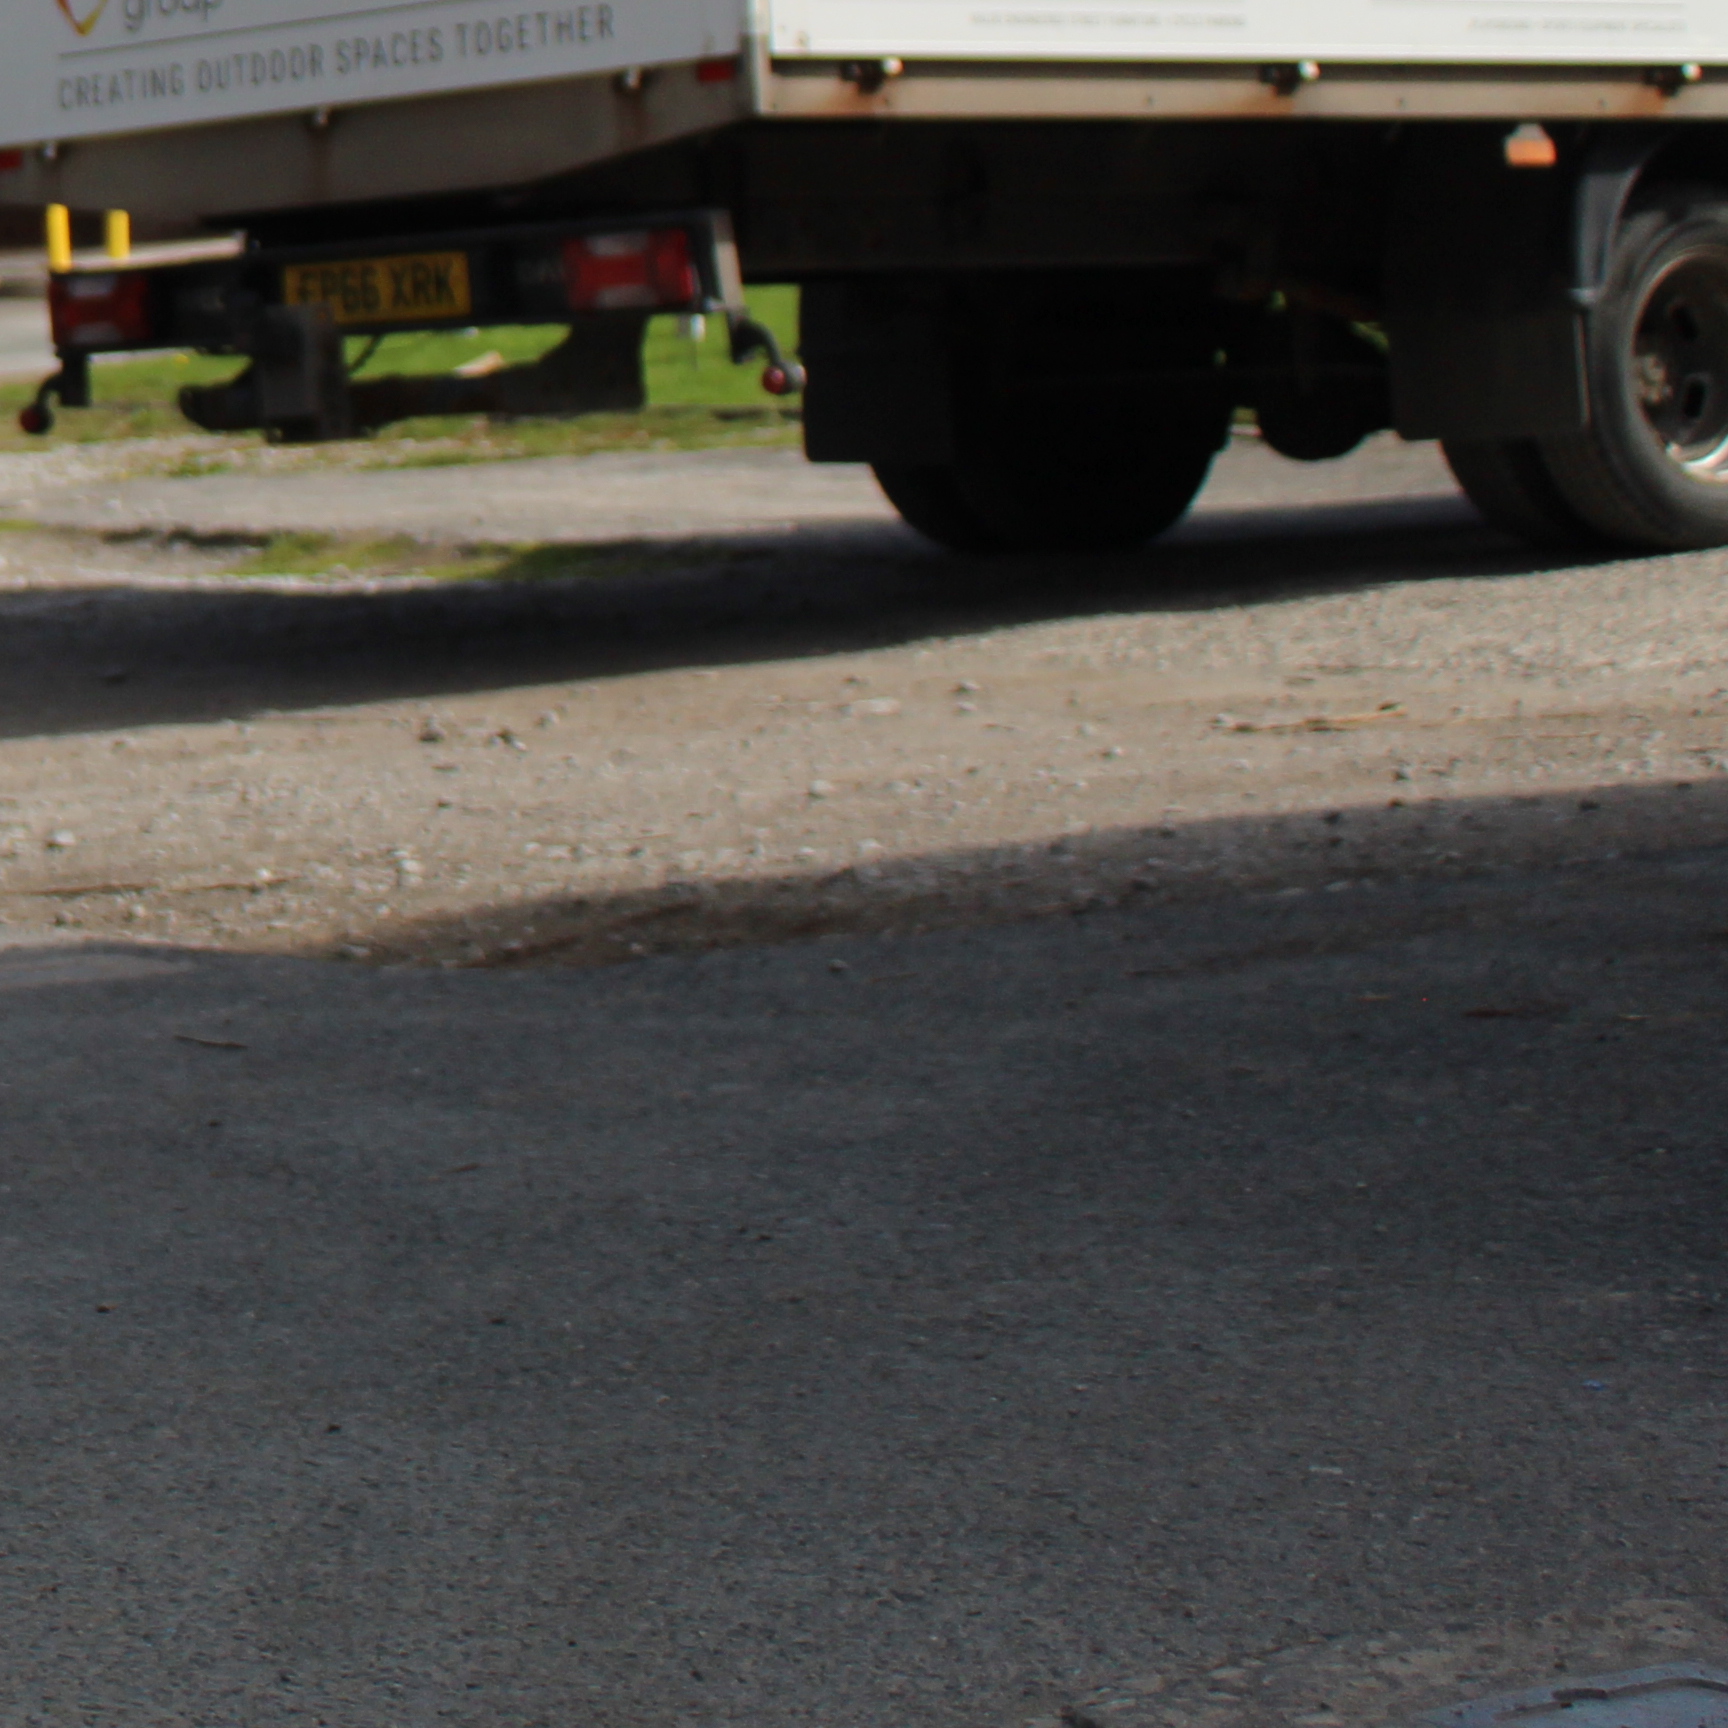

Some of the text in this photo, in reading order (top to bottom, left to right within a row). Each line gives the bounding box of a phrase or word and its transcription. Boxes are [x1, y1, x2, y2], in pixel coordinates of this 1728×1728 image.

[57, 3, 615, 111] CREATING OUTDOOR SPACES TOGETHER
